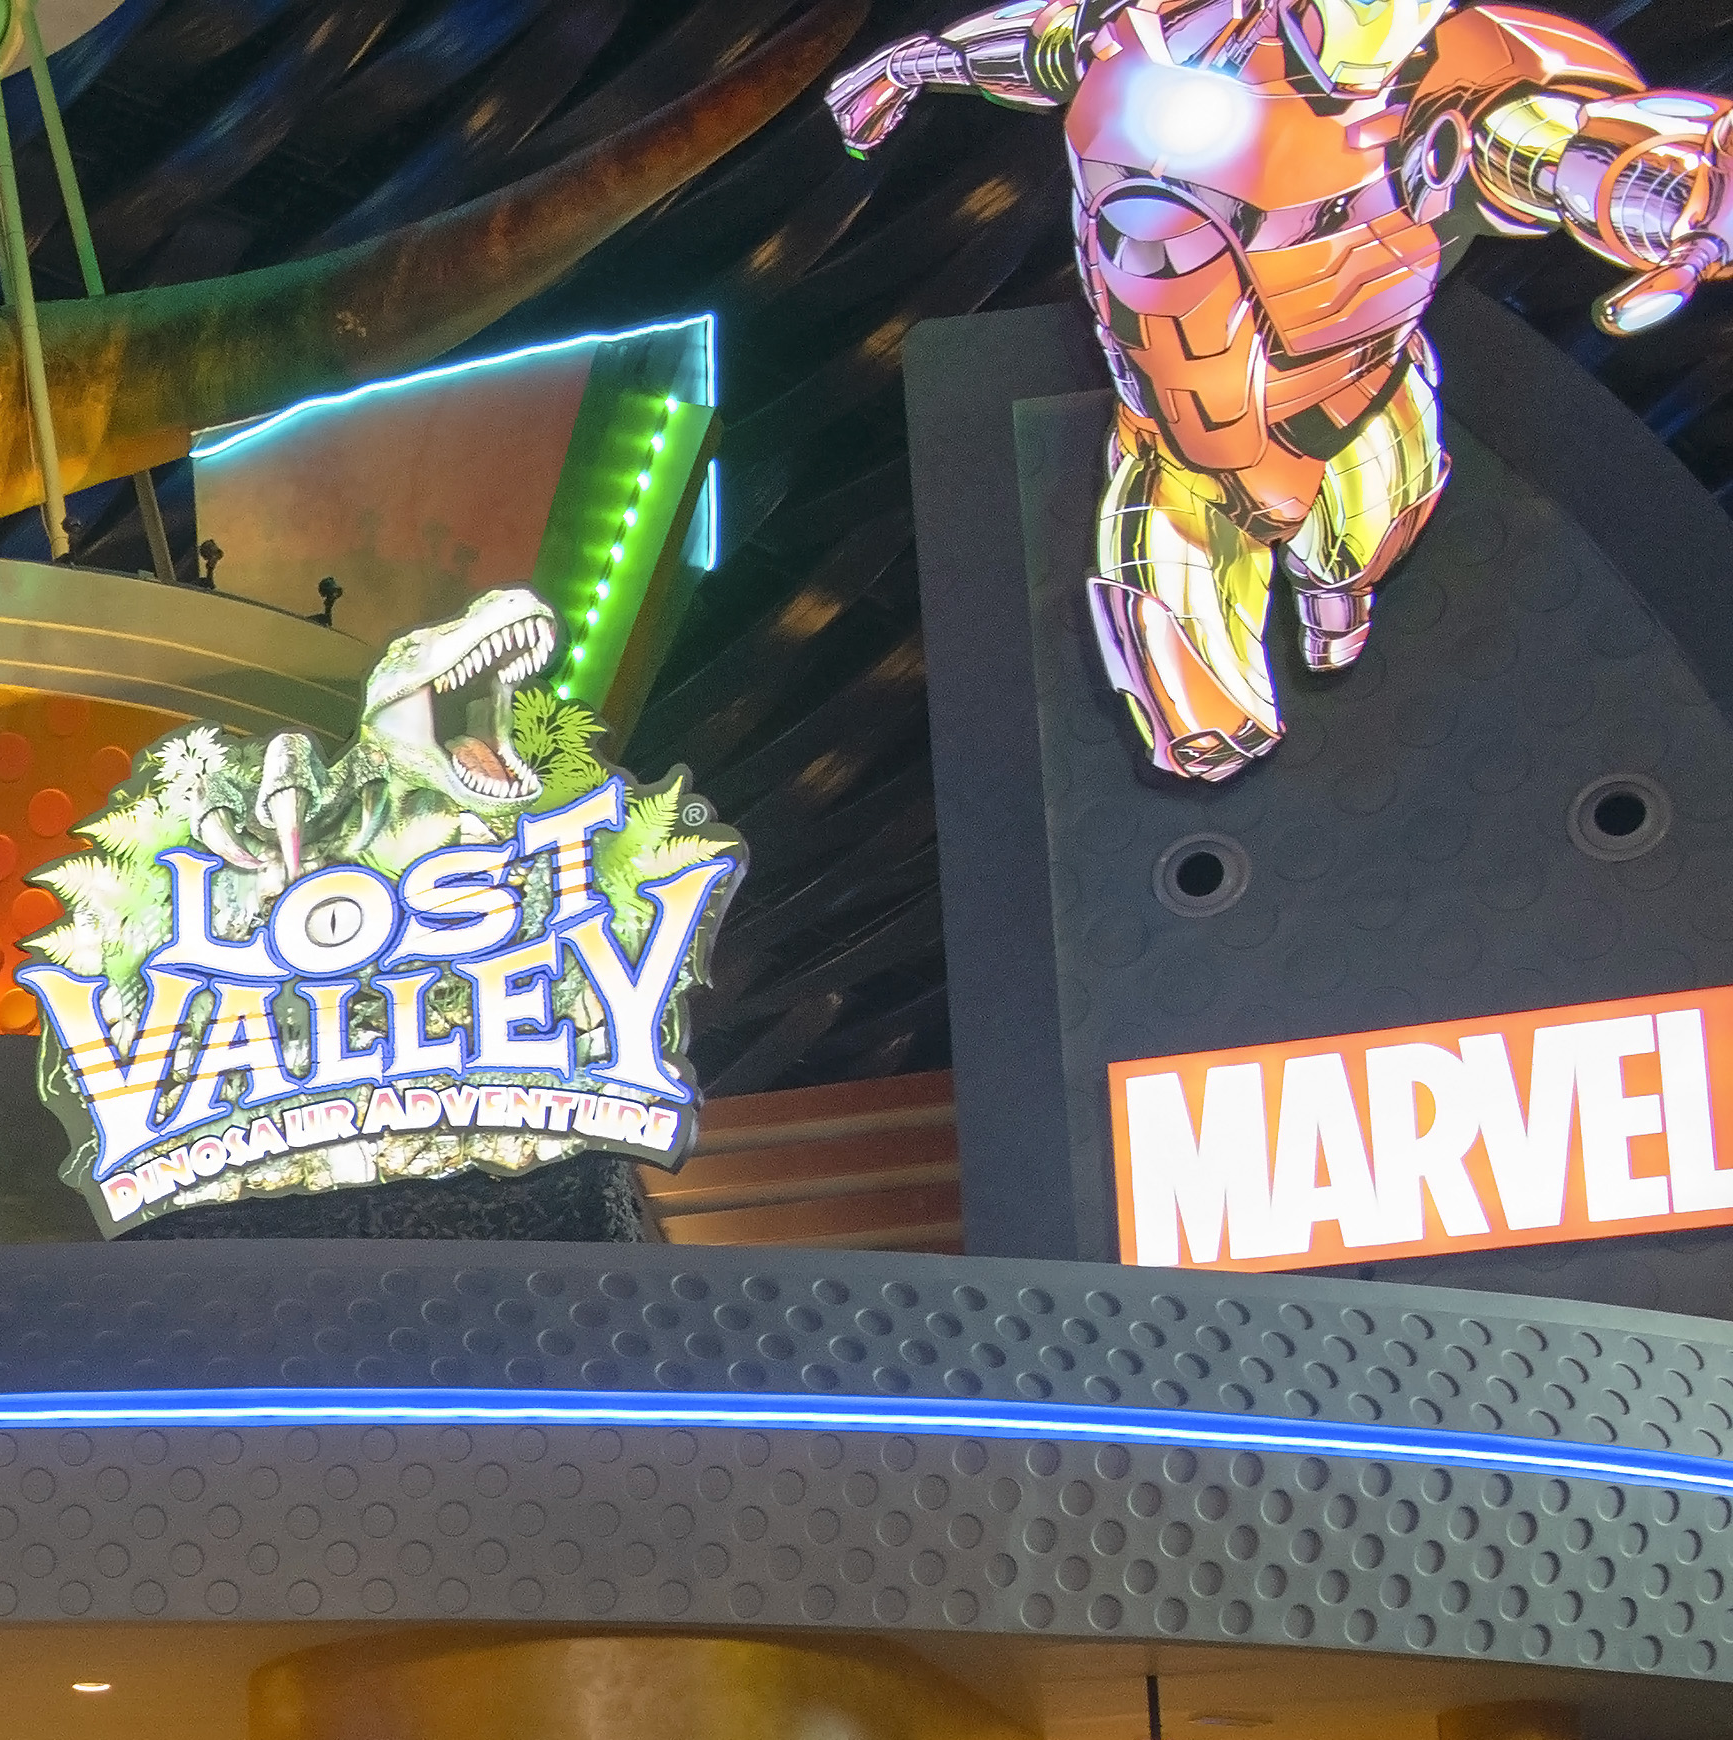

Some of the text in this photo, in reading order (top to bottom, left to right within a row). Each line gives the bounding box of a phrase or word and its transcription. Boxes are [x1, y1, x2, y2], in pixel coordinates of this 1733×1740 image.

[145, 775, 625, 978] LOST
[15, 856, 733, 1181] VALLEY
[101, 1084, 681, 1223] DINOSAUR ADVENTURE
[1125, 1009, 1733, 1267] MARVEL
